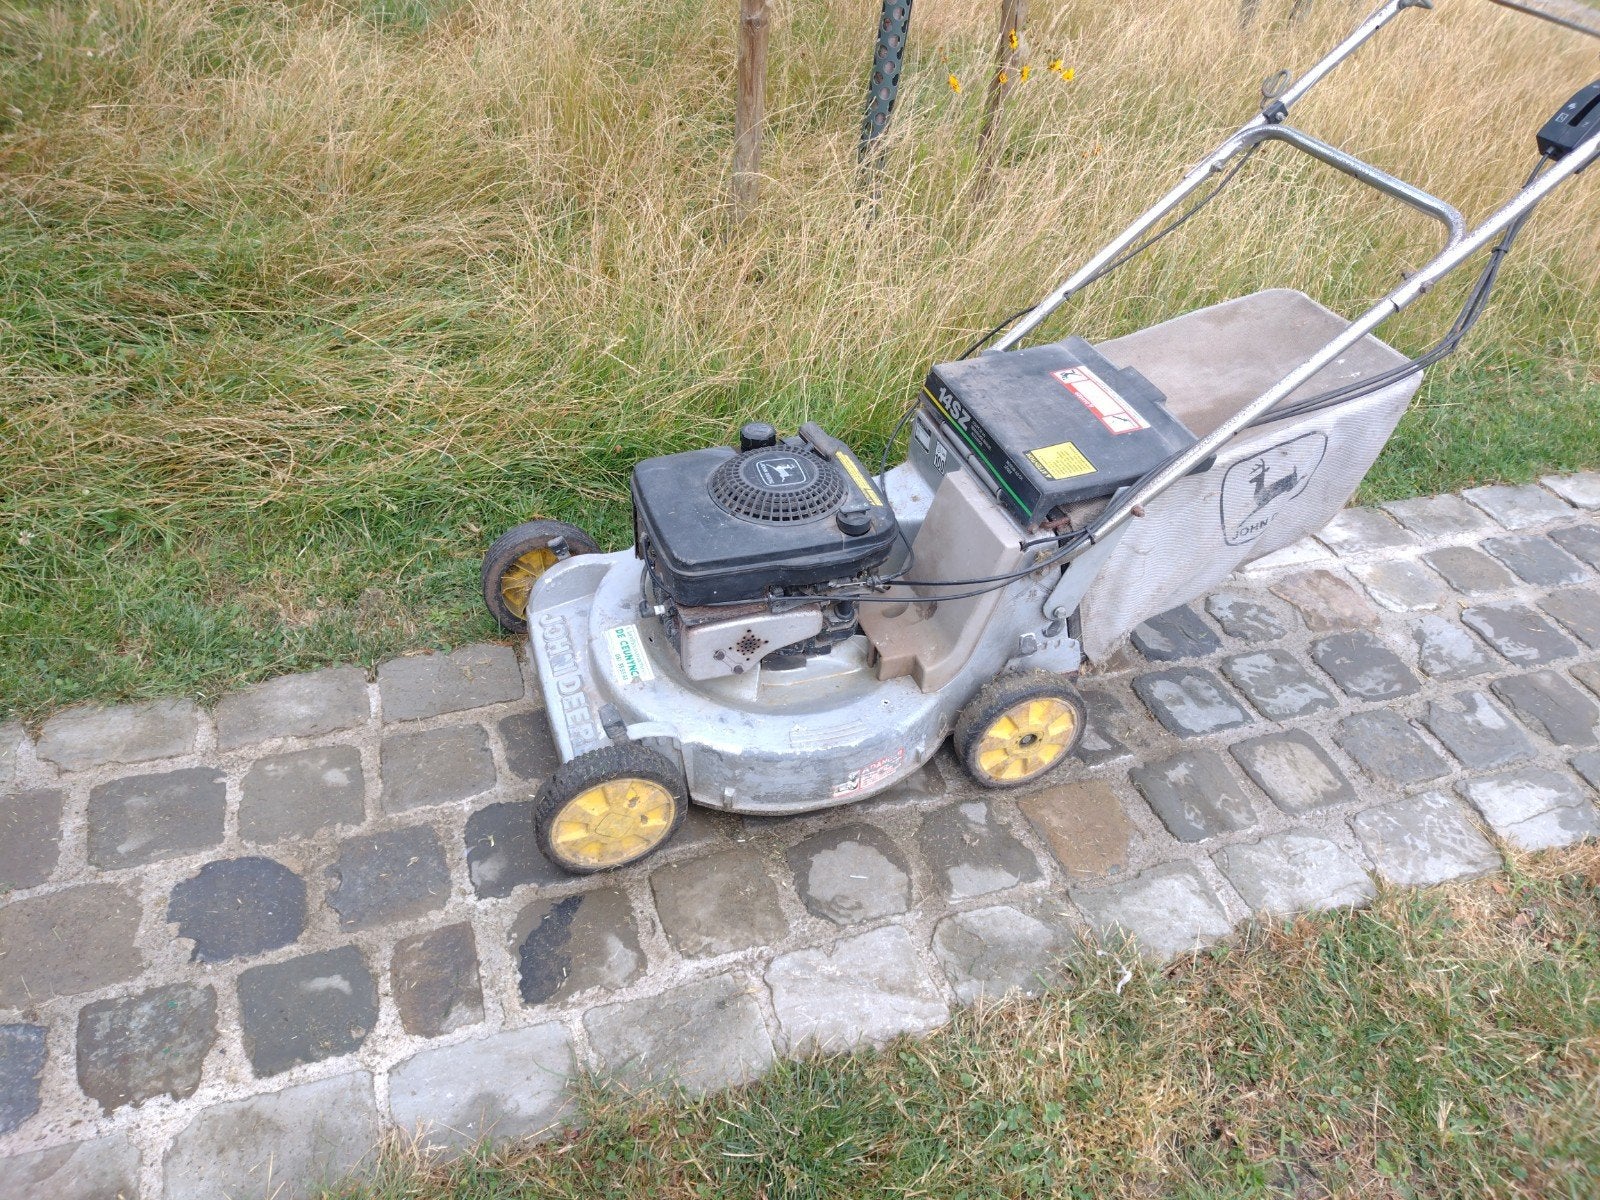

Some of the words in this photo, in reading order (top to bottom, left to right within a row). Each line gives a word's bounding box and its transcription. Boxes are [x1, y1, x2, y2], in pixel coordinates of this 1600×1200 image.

[938, 387, 971, 431] 14SZ
[1232, 518, 1269, 540] JOHN
[540, 614, 578, 677] JOHN
[615, 628, 626, 639] DE
[558, 674, 595, 746] DEER
